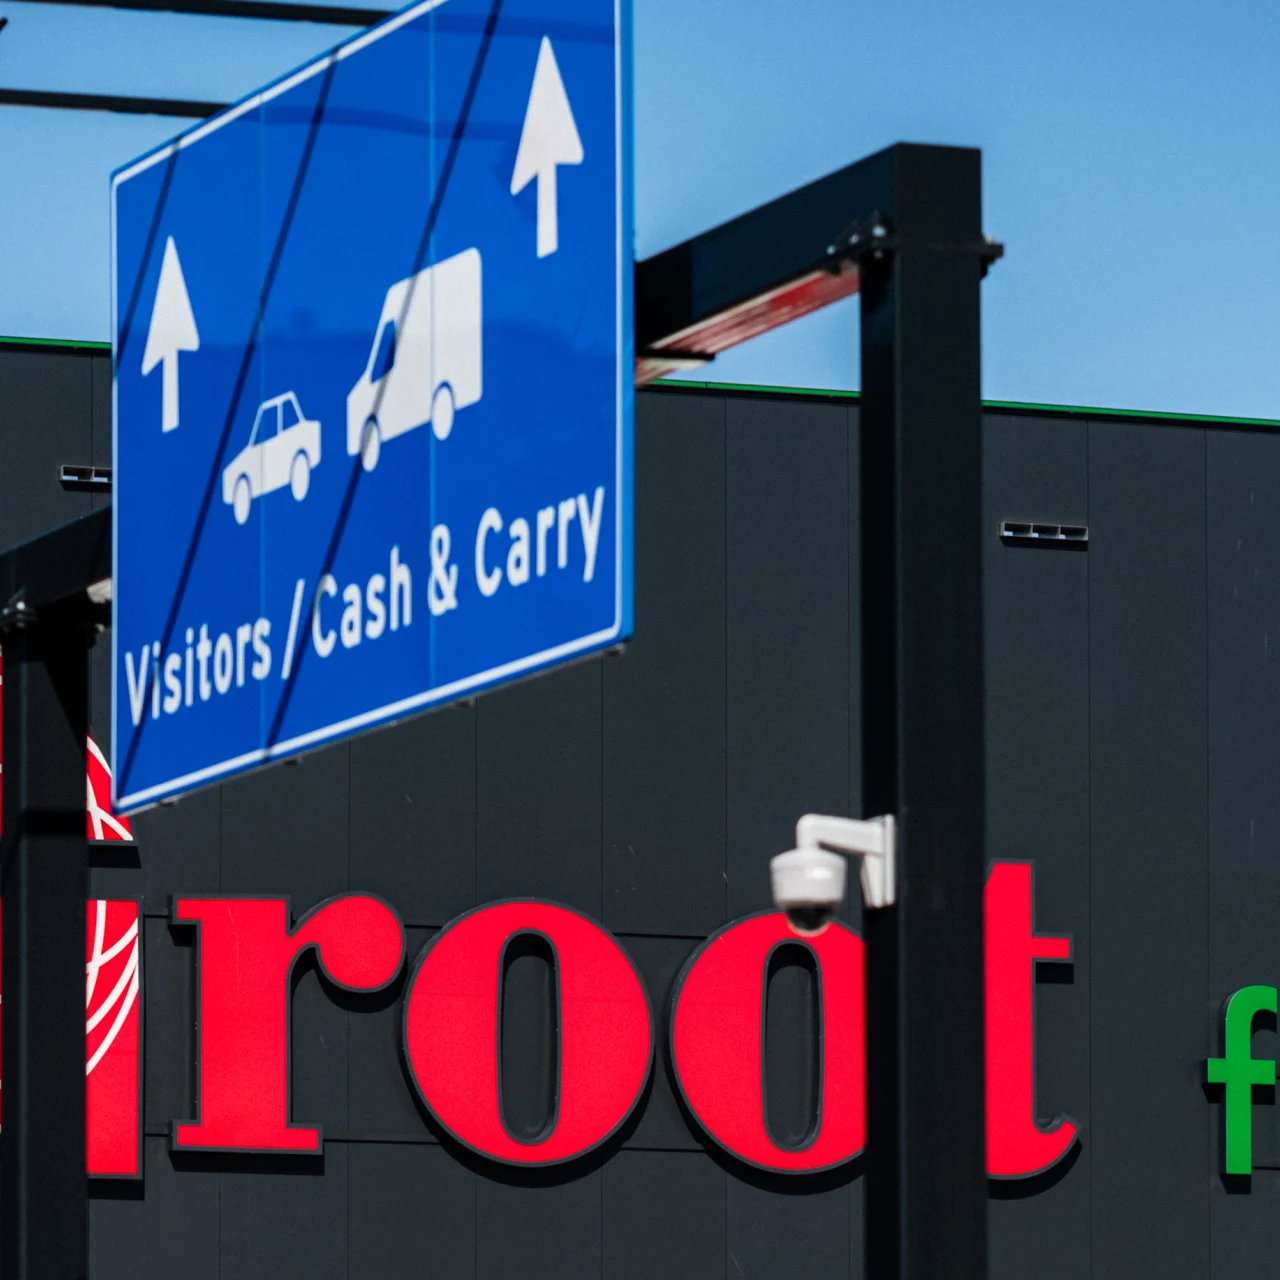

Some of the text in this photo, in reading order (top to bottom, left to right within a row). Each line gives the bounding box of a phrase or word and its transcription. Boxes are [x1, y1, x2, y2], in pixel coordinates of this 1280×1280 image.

[125, 618, 272, 727] Visitors
[312, 545, 412, 657] Cash
[428, 524, 458, 616] &
[475, 487, 605, 596] Carry
